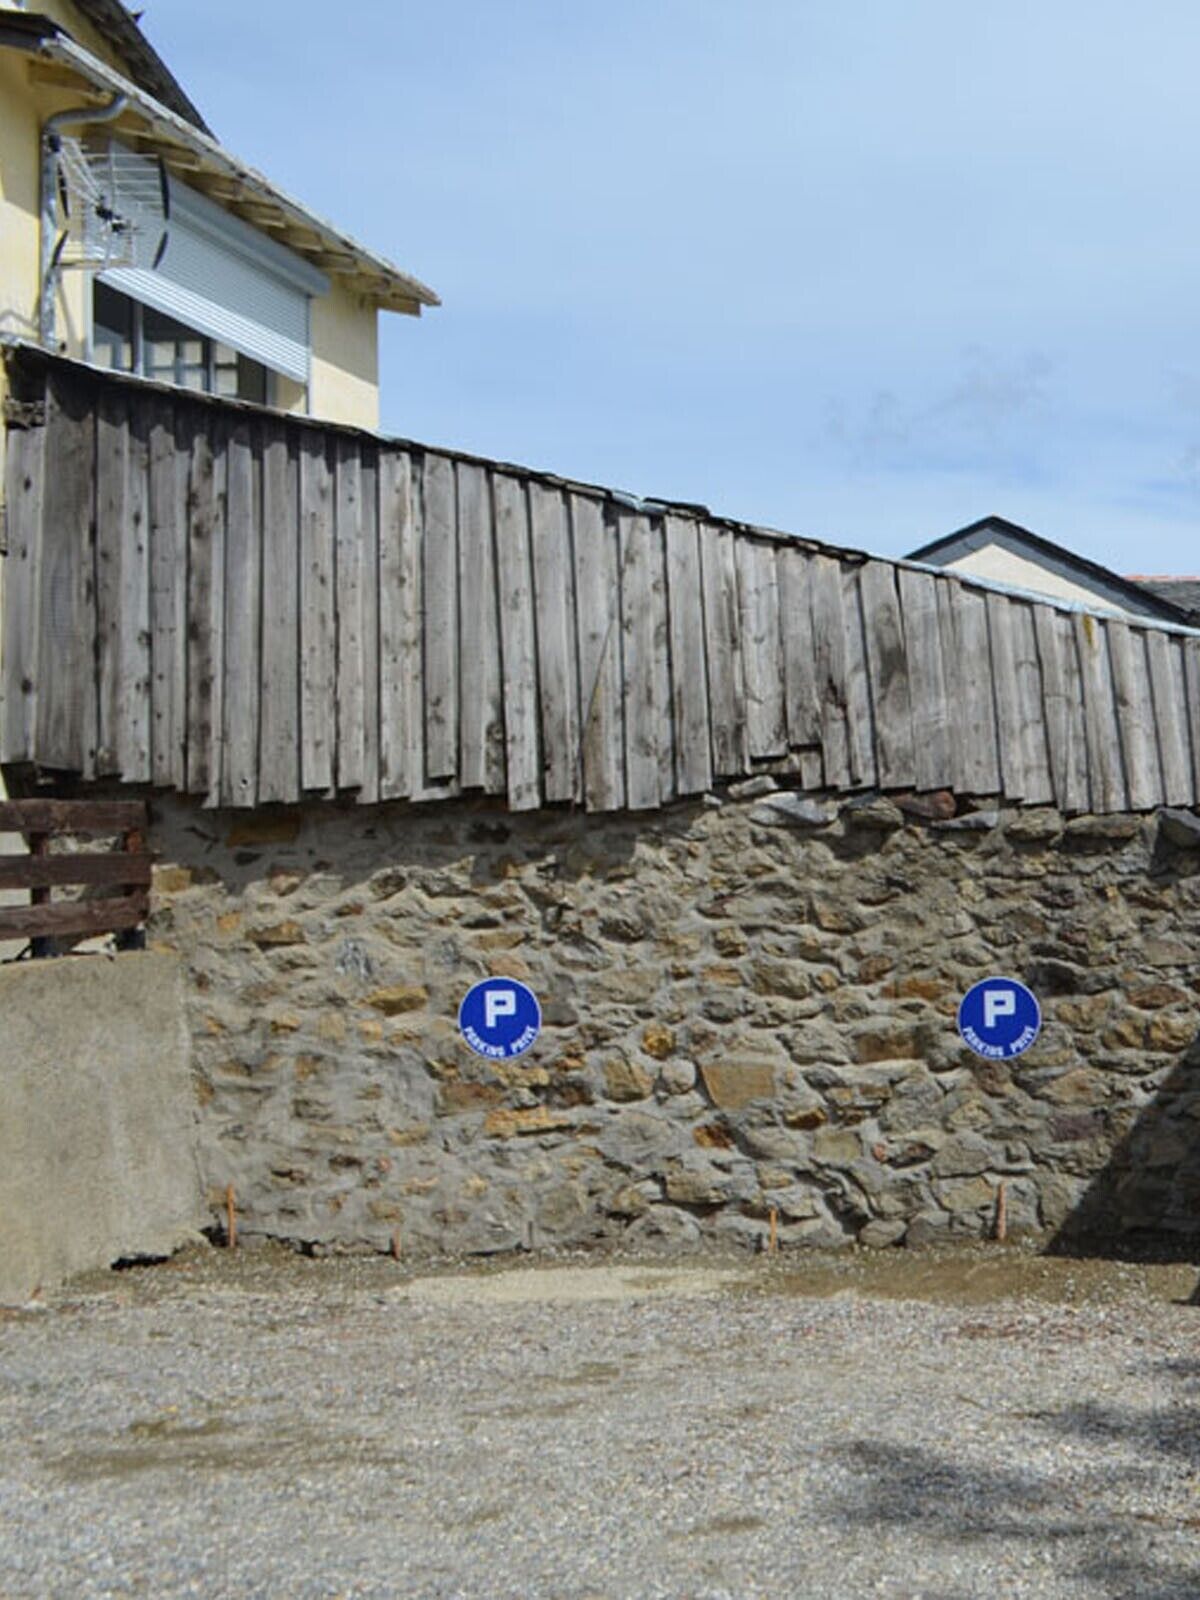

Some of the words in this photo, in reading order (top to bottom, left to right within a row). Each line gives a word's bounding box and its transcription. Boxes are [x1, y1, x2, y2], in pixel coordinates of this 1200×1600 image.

[485, 990, 515, 1027] P
[984, 990, 1015, 1027] P
[463, 1026, 506, 1057] PARKING
[962, 1026, 1004, 1056] PARKING
